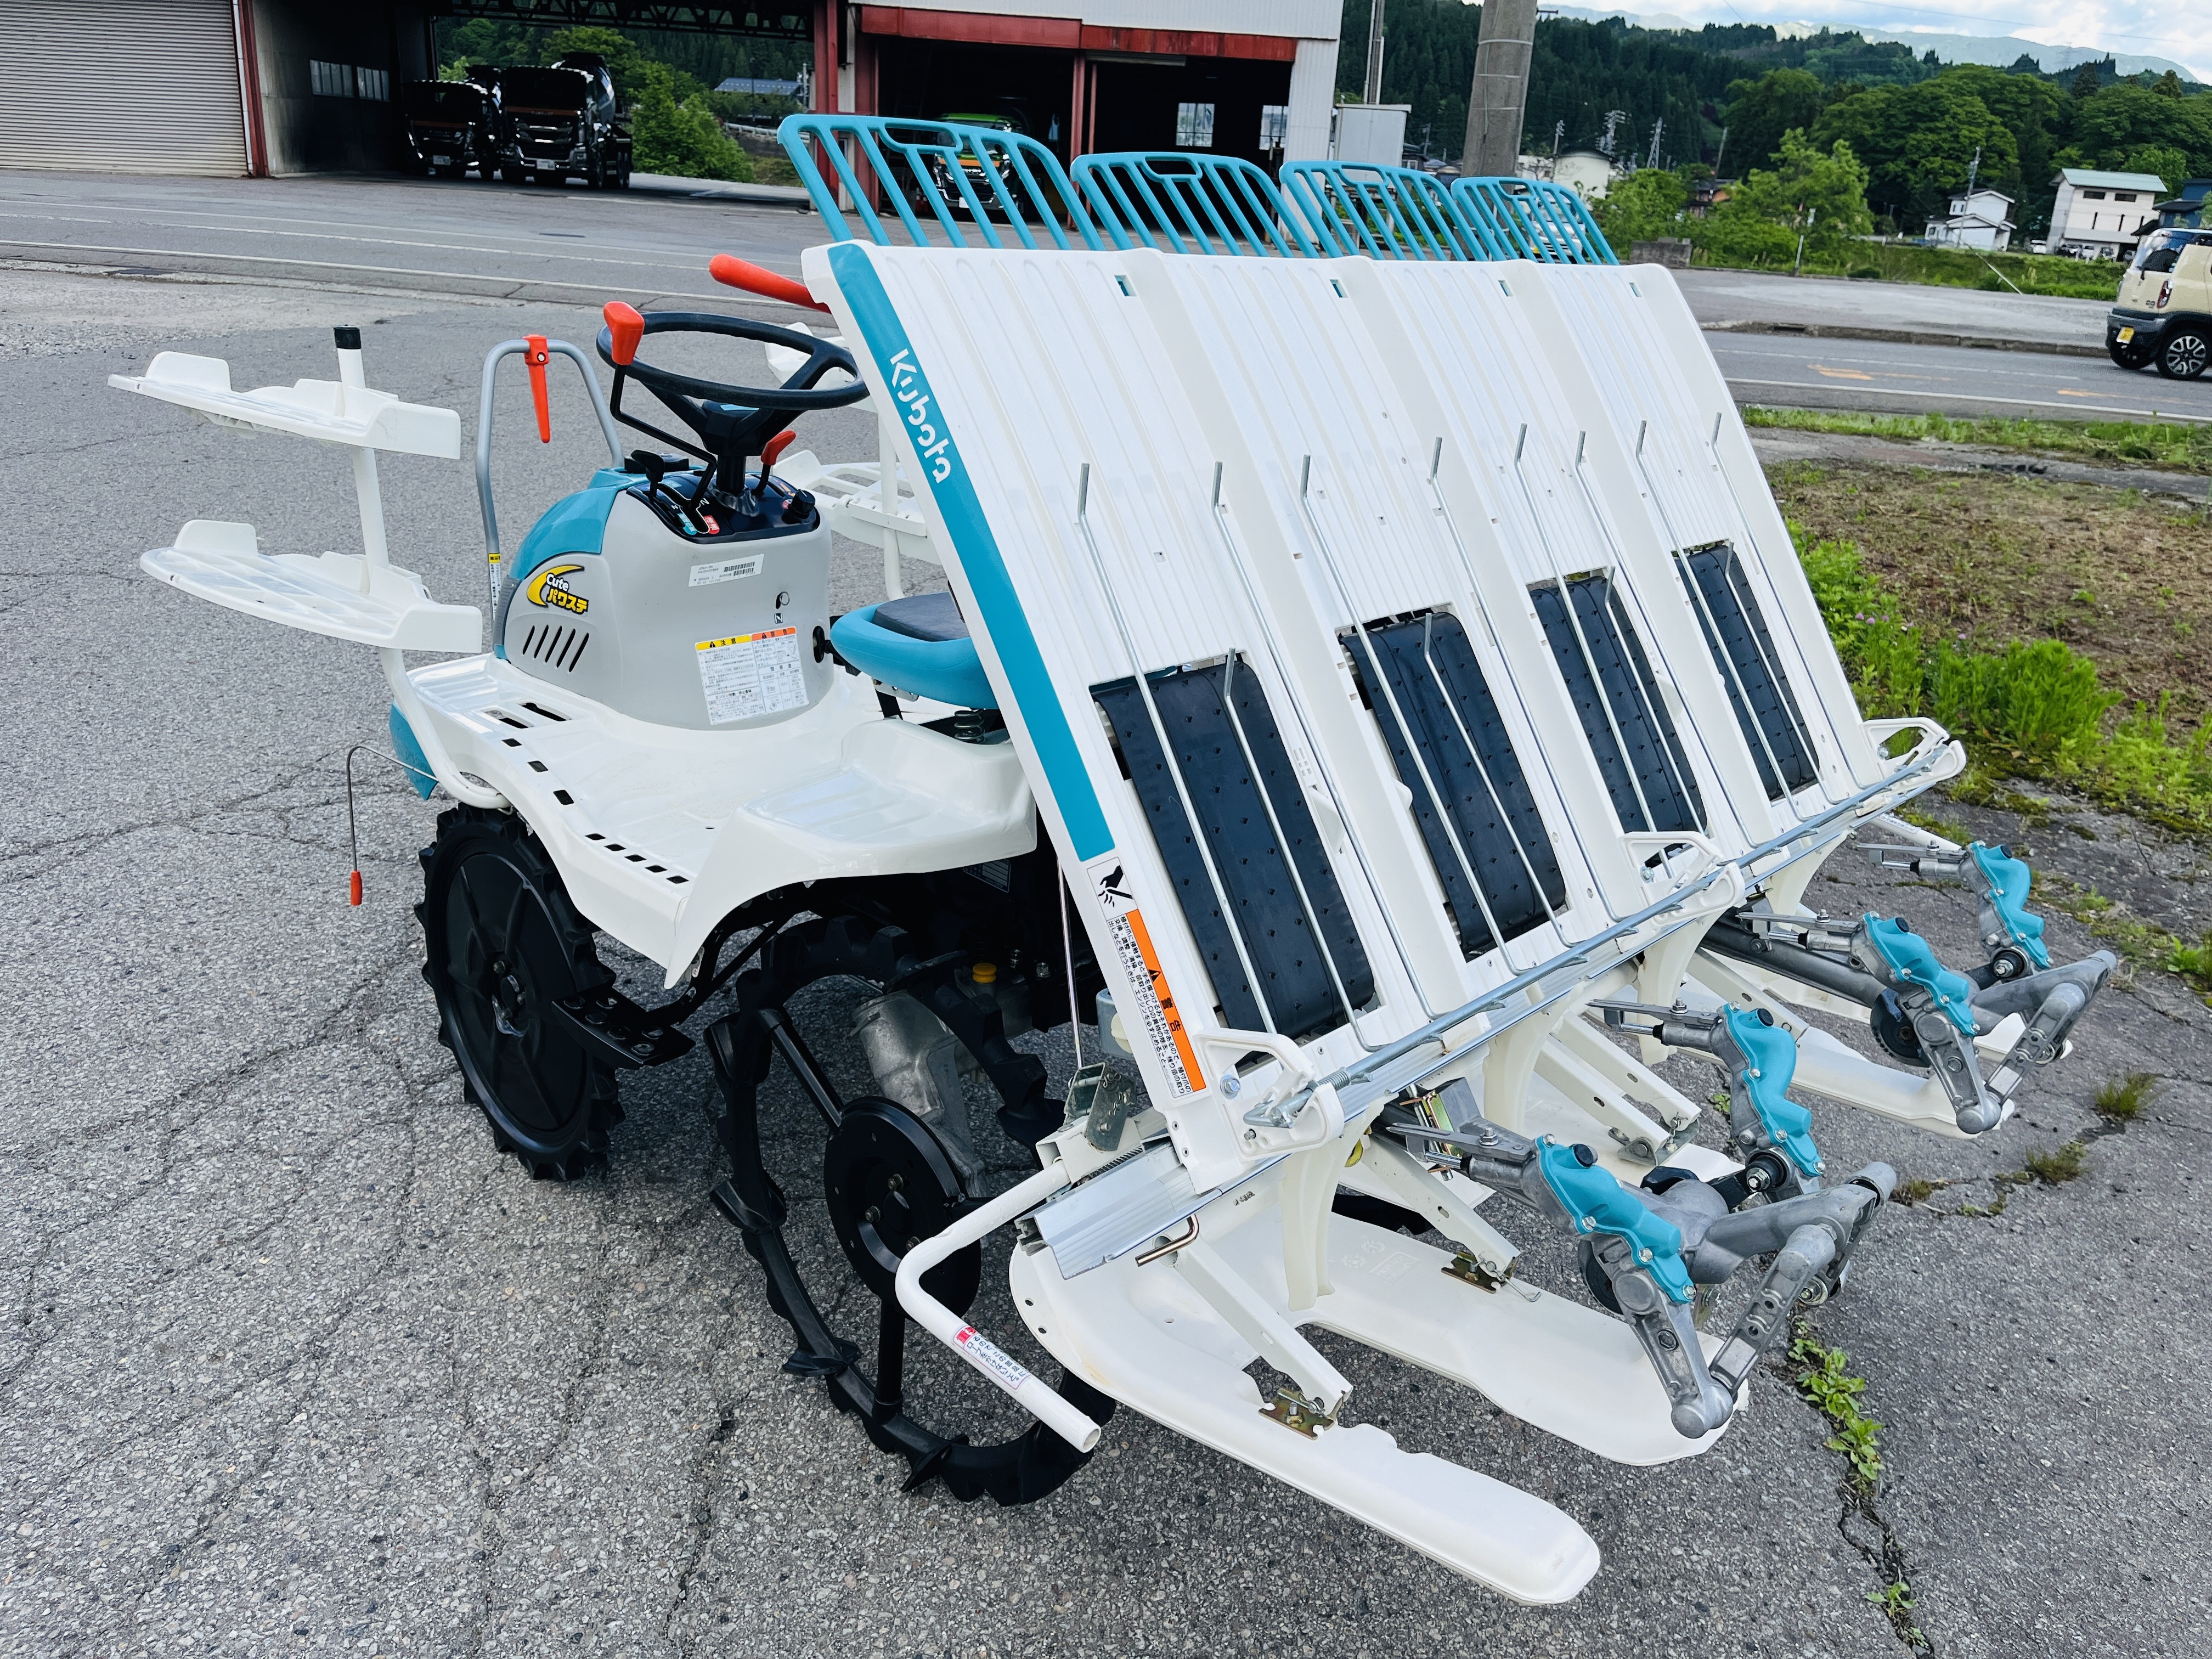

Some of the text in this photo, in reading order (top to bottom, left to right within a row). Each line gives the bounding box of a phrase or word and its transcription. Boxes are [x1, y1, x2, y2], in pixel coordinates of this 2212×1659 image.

[890, 348, 951, 484] Kubota
[546, 573, 569, 591] Cute
[547, 589, 588, 613] パワステ
[1160, 996, 1182, 1032] 警告
